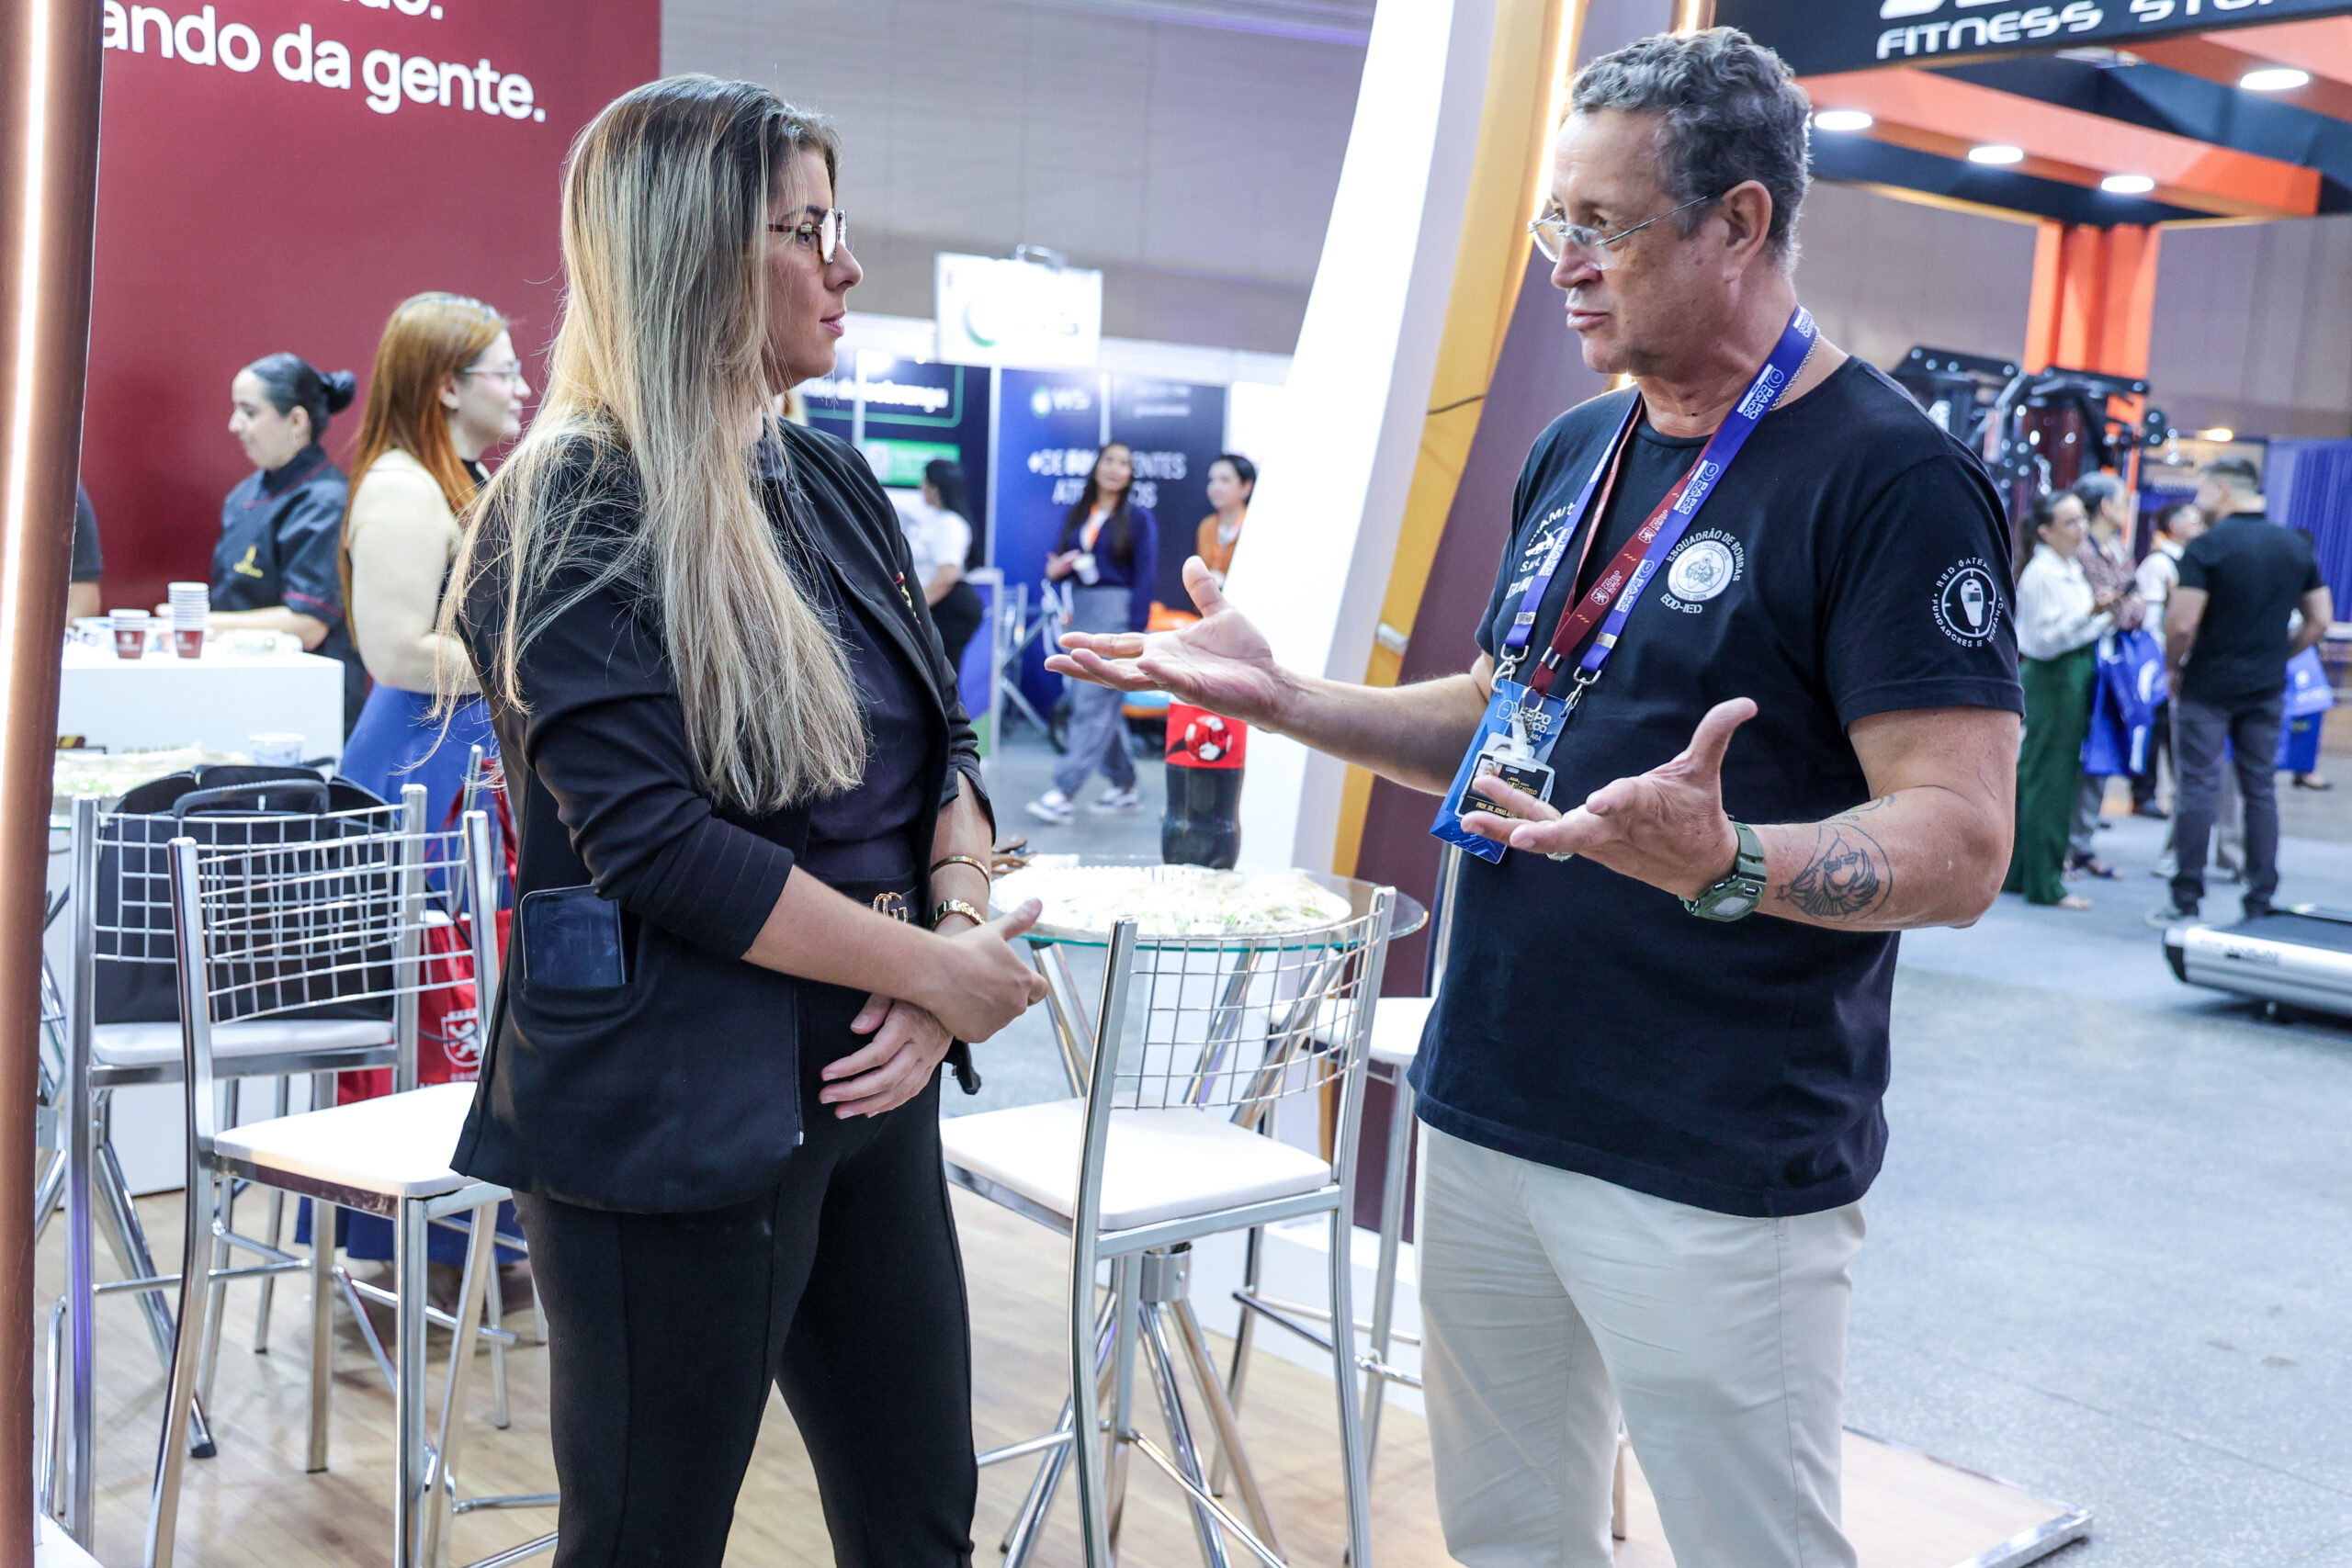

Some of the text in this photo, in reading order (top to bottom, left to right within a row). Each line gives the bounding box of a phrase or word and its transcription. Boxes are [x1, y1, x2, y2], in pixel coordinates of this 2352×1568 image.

[1876, 0, 2104, 60] FITNESS
[272, 23, 351, 89] da
[362, 49, 547, 122] gente.
[1743, 384, 1768, 417] CONDO
[1747, 387, 1775, 420] PAPO
[1683, 481, 1709, 514] PAPO
[1721, 532, 1736, 546] DE
[1730, 541, 1745, 581] BOMBAS
[1622, 579, 1645, 613] PAPO
[1931, 599, 1973, 648] FUNDADORES
